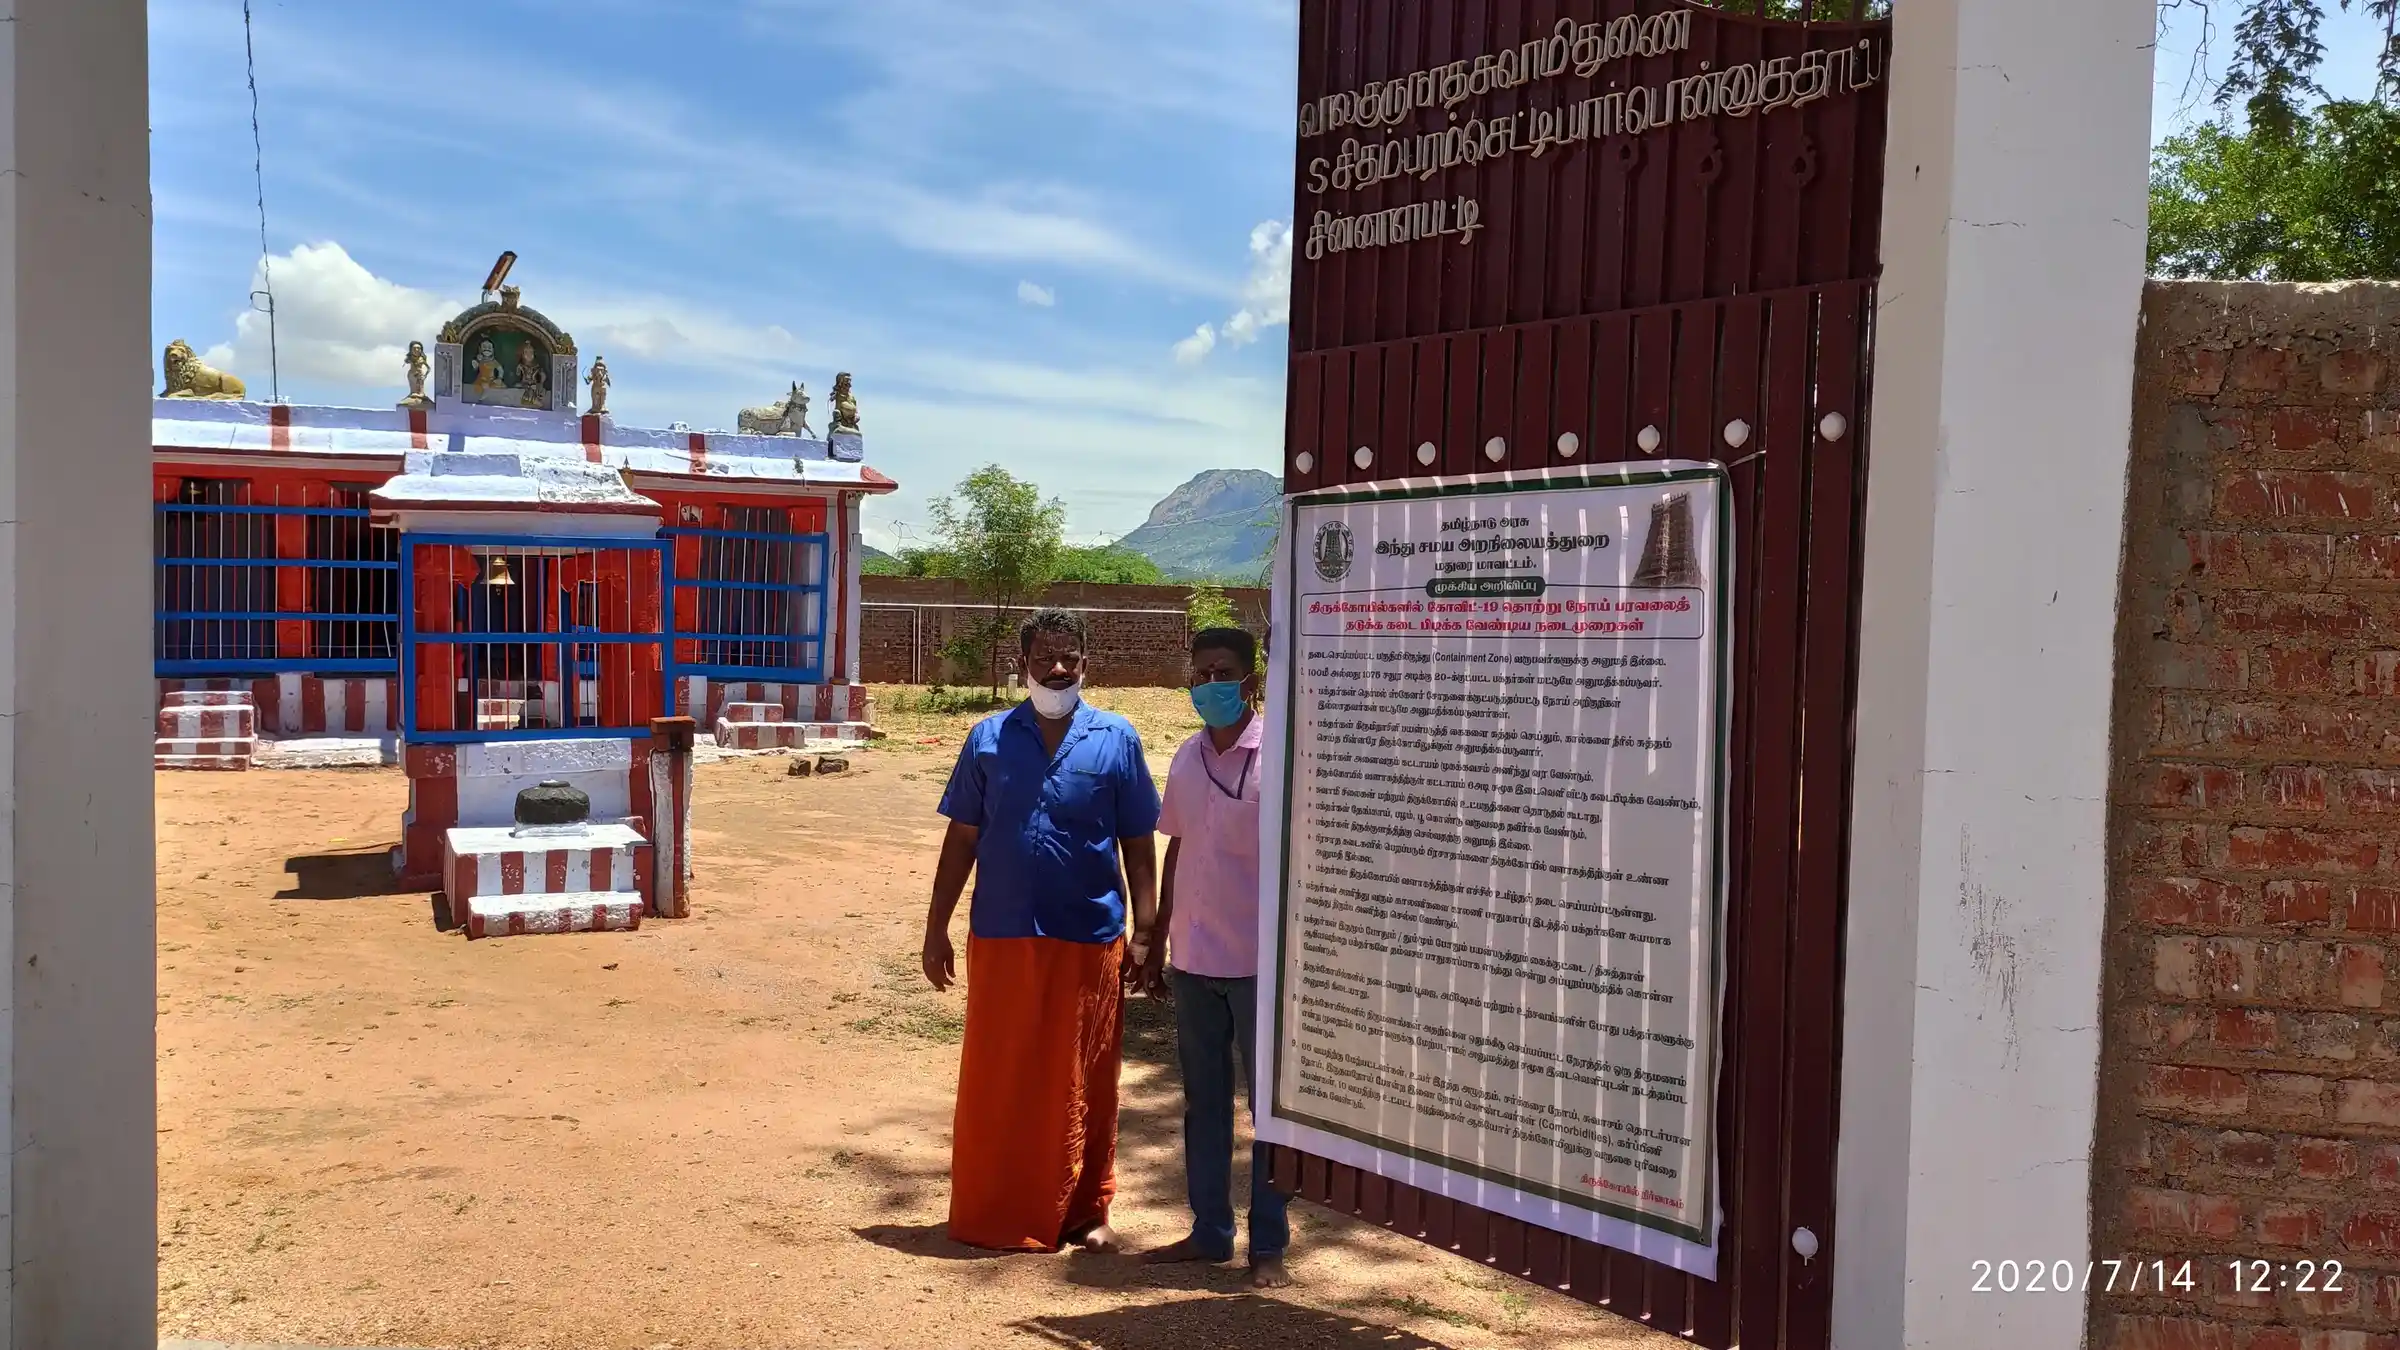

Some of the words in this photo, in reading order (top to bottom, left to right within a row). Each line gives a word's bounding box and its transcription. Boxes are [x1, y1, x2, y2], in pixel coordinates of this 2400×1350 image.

[1439, 517, 1496, 533] தமிழ்நாடு
[1499, 517, 1529, 528] அரசு
[1374, 538, 1415, 557] இந்து
[1418, 540, 1454, 552] சமய
[1457, 532, 1609, 553] அறநிலையத்துறை
[1434, 561, 1474, 573] மதுரை
[1476, 556, 1536, 569] மாவட்டம்.
[1434, 578, 1477, 594] முக்கிய
[1479, 579, 1536, 592] அறிவிப்பு
[1308, 600, 1424, 614] திருக்கோயில்களில்
[1427, 600, 1498, 612] கோவிட்-19
[1501, 599, 1561, 615] தொற்று
[1565, 597, 1610, 614] நோய்
[1614, 597, 1690, 612] பரவலைத்
[1344, 618, 1383, 632] தடுக்க
[1385, 620, 1417, 630] கடை
[1420, 618, 1462, 632] பிடிக்க
[1465, 618, 1531, 632] வேண்டிய
[1533, 619, 1644, 633] நடைமுறைகள்
[1431, 651, 1486, 663] (Containment
[1487, 652, 1512, 664] Zone)
